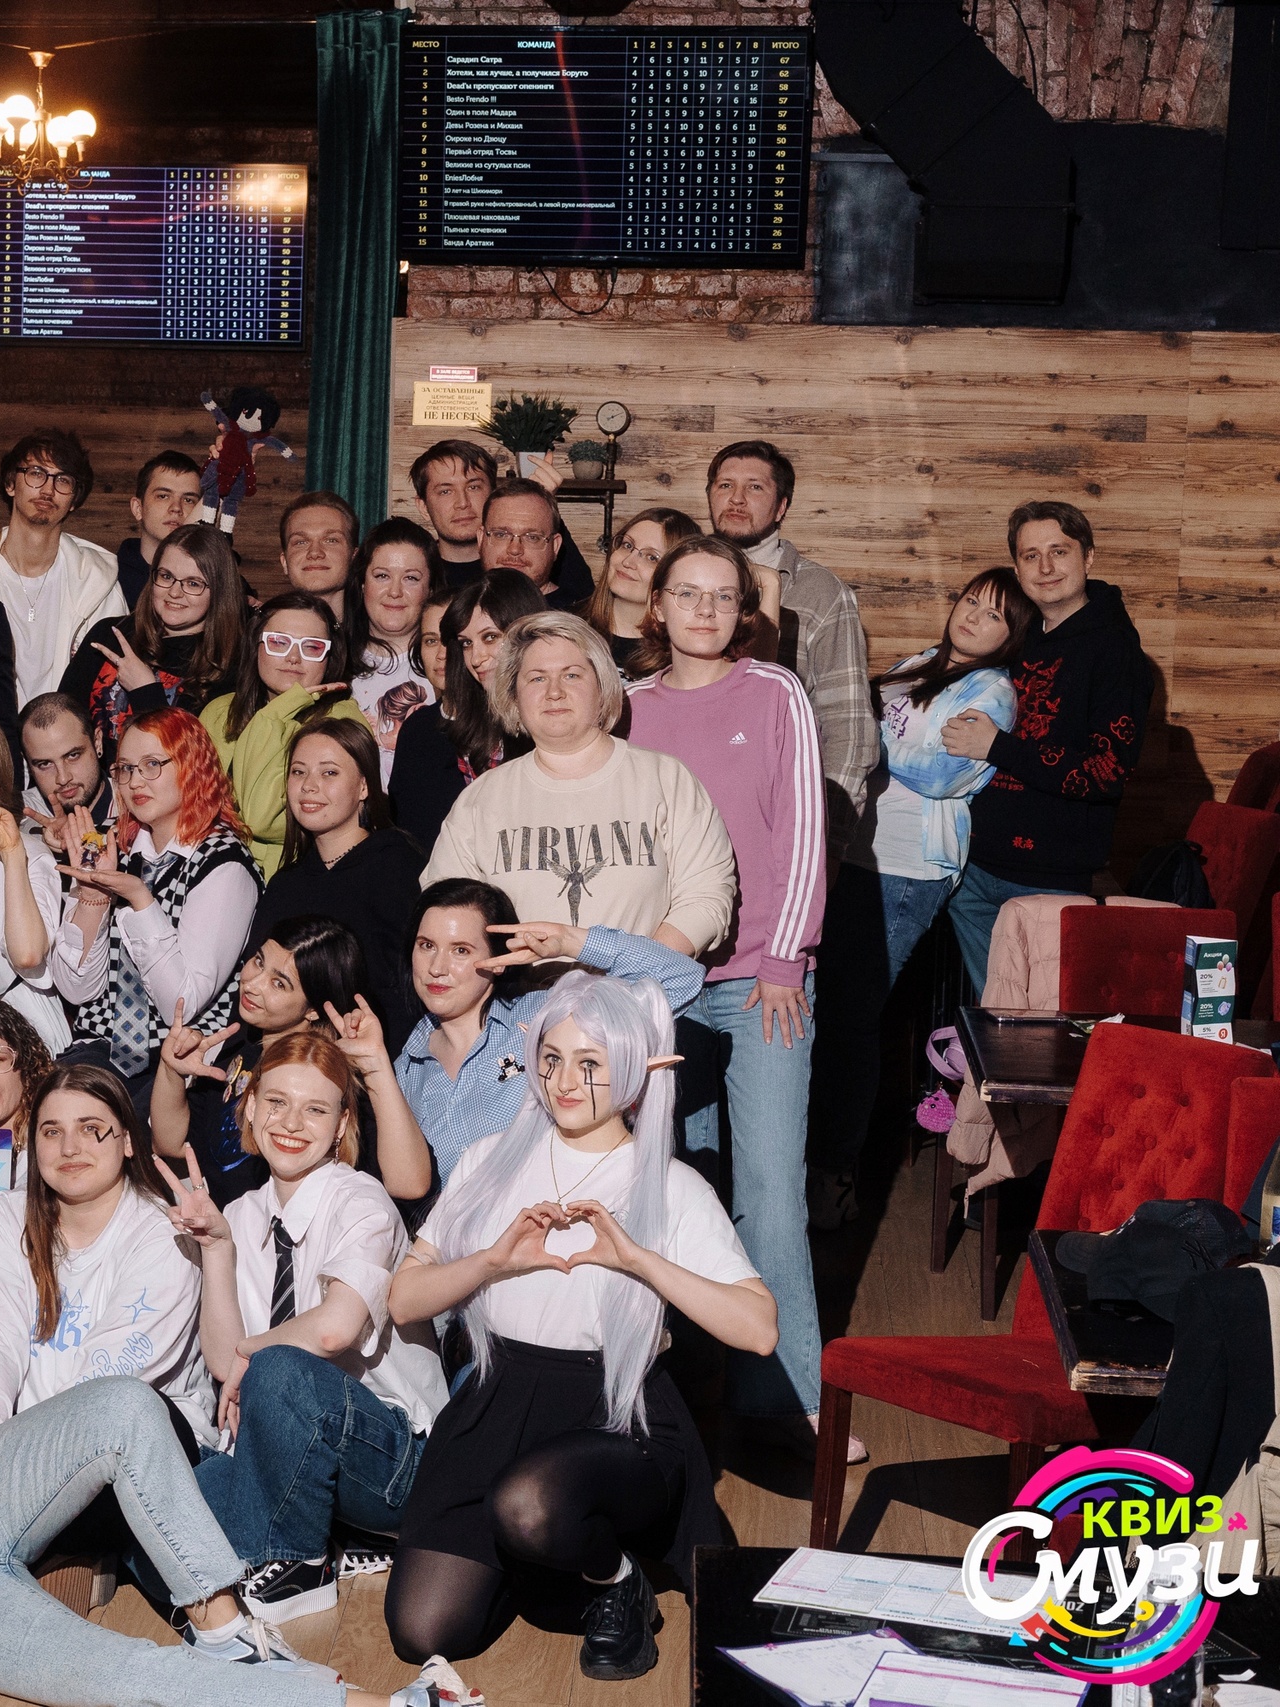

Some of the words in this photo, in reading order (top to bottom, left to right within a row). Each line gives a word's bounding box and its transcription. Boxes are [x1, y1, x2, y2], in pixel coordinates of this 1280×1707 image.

[517, 41, 556, 49] КОМАНДА
[633, 41, 638, 49] 1
[650, 41, 656, 49] 2
[667, 41, 673, 49] 3
[684, 41, 690, 49] 4
[701, 41, 707, 49] 5
[718, 41, 724, 49] 6
[735, 41, 741, 49] 7
[753, 41, 759, 49] 8
[771, 41, 800, 49] ИТОГО
[447, 56, 479, 64] Сарадип
[480, 56, 503, 64] Сатра
[446, 69, 475, 78] Хотели,
[489, 70, 514, 78] лучше,
[522, 70, 560, 78] получился
[561, 70, 589, 78] Боруто
[779, 70, 789, 78] 62
[473, 83, 517, 91] пропускают
[518, 83, 554, 91] опенинги
[422, 95, 428, 103] 4
[446, 95, 465, 103] Besto
[465, 95, 490, 103] Frendo
[422, 108, 428, 116] 5
[446, 108, 465, 117] Один
[490, 109, 517, 117] Мадара
[421, 121, 427, 129] 6
[445, 122, 464, 130] Девы
[496, 122, 523, 130] Михаил
[483, 135, 507, 144] Дзюцу
[445, 148, 472, 156] Первый
[473, 149, 494, 157] отряд
[775, 150, 786, 158] 49
[421, 161, 427, 169] 9
[445, 161, 473, 169] Великие
[483, 162, 512, 170] сутулых
[114, 193, 136, 201] Боруто
[444, 213, 480, 221] Плюшевая
[443, 239, 464, 247] Банда
[465, 239, 494, 247] Аратаки
[424, 412, 439, 420] НЕ
[491, 819, 657, 876] NIRVANA
